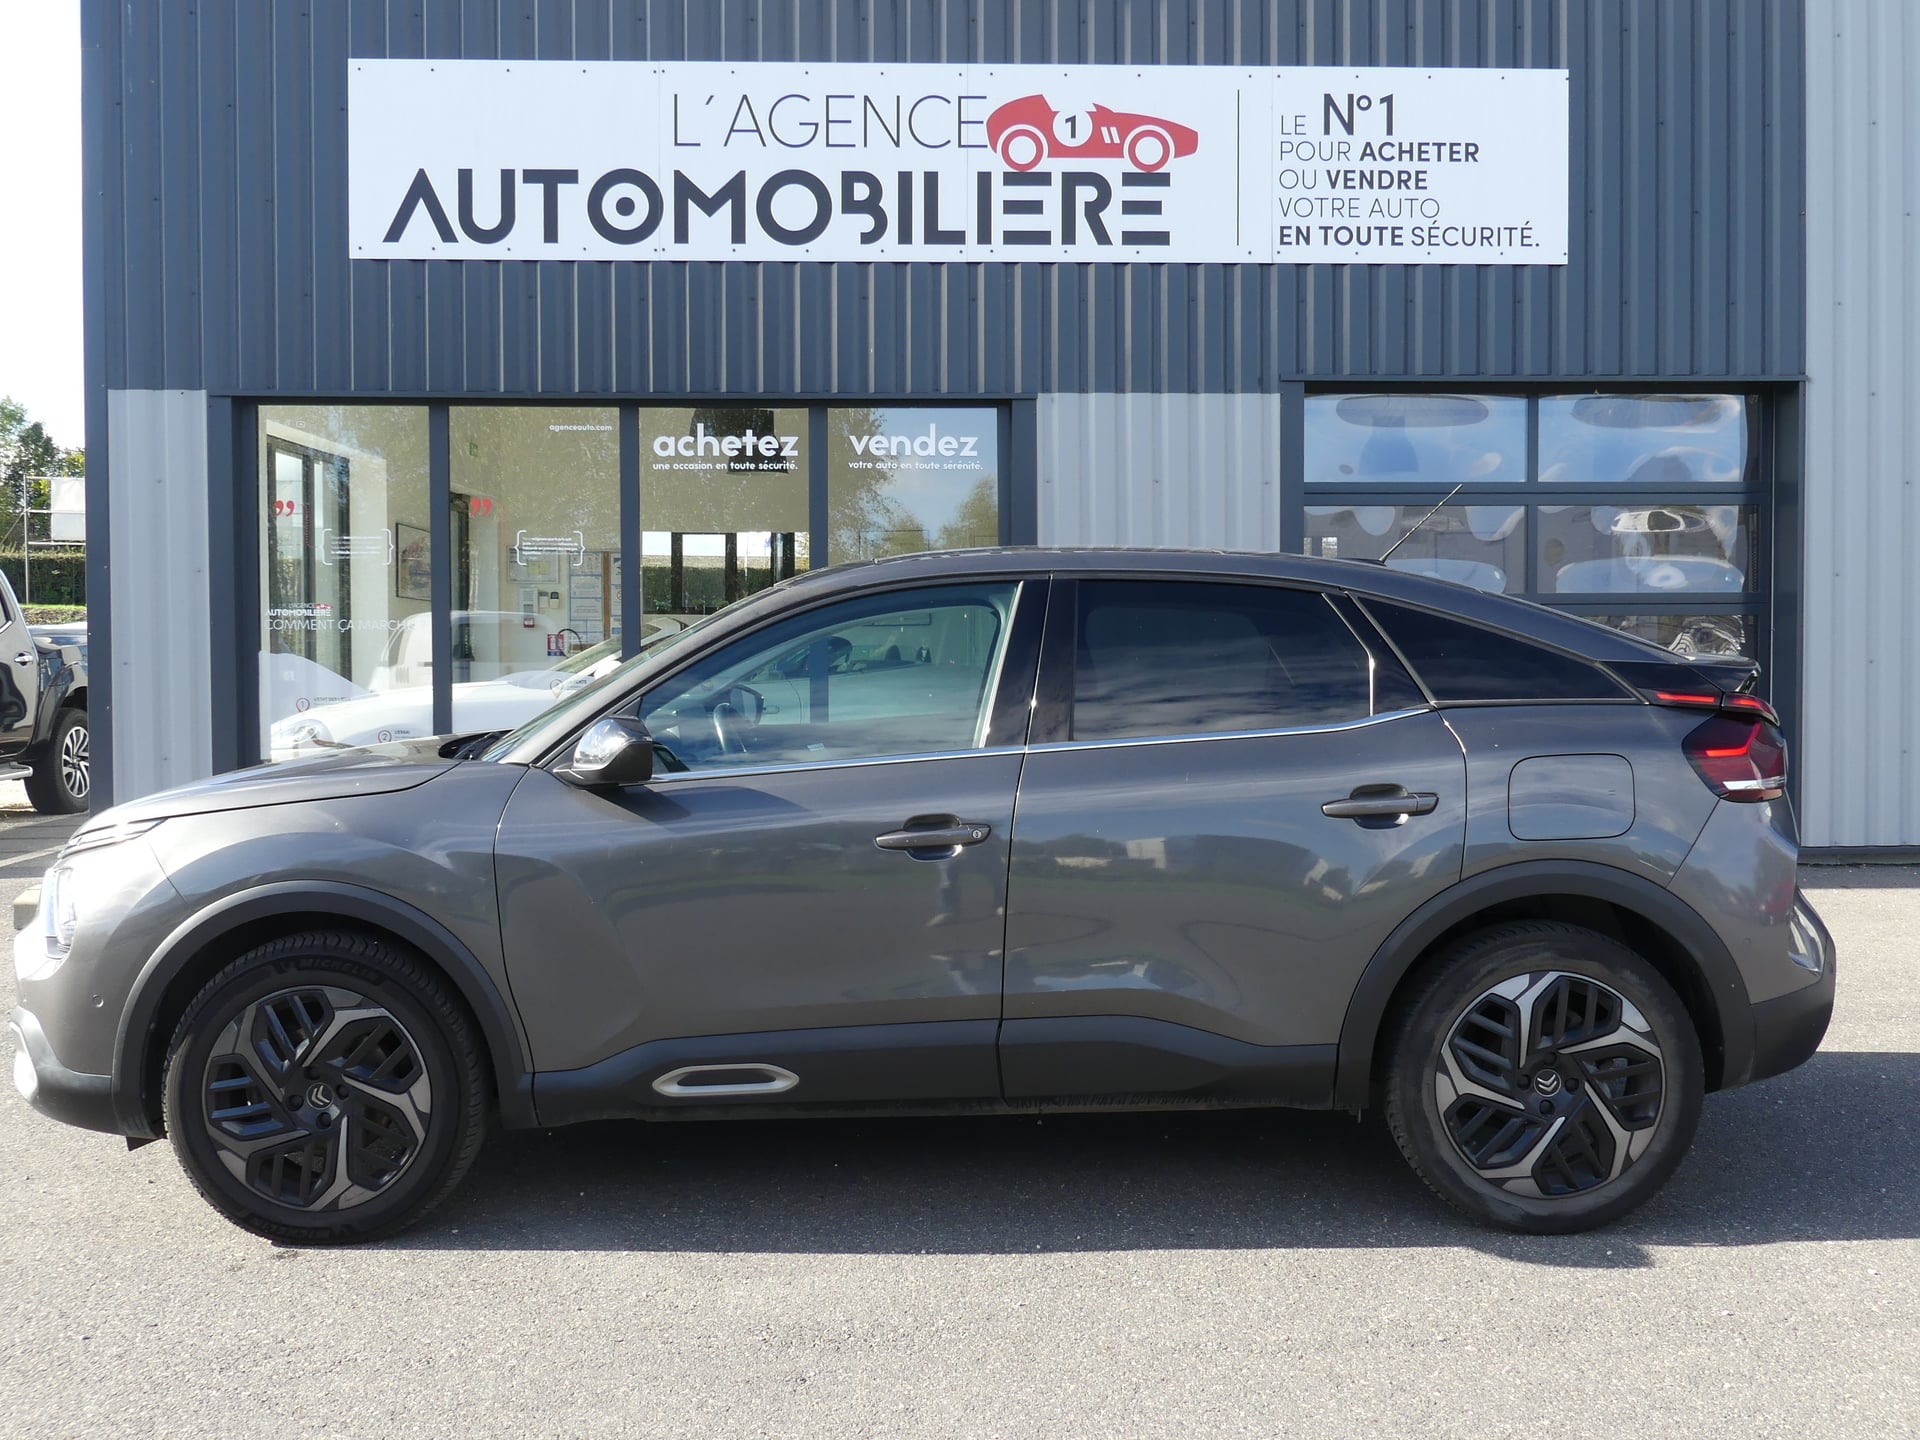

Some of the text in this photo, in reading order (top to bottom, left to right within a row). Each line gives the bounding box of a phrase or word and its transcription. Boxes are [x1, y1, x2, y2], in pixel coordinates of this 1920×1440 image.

[673, 93, 987, 149] L'AGENCE
[1064, 115, 1077, 139] 1
[1279, 114, 1307, 136] LE
[1279, 140, 1480, 163] POUR ACHETER
[1278, 168, 1428, 191] OU VENDRE
[382, 167, 1171, 246] AUTOMOBILIERE
[1278, 197, 1441, 219] VOTRE AUTO
[1279, 219, 1540, 248] EN TOUTE SÉCURITÉ.
[549, 424, 613, 432] agenceauto.com
[652, 423, 800, 457] achetez
[849, 423, 979, 457] vendez
[672, 461, 711, 470] occasion
[729, 461, 756, 470] toute
[758, 461, 798, 470] sécurité.
[848, 461, 873, 469] votre
[875, 461, 898, 469] auto
[915, 461, 940, 469] toute
[943, 461, 983, 470] sérénité.
[265, 619, 335, 631] COMMENT
[337, 618, 353, 633] ÇA
